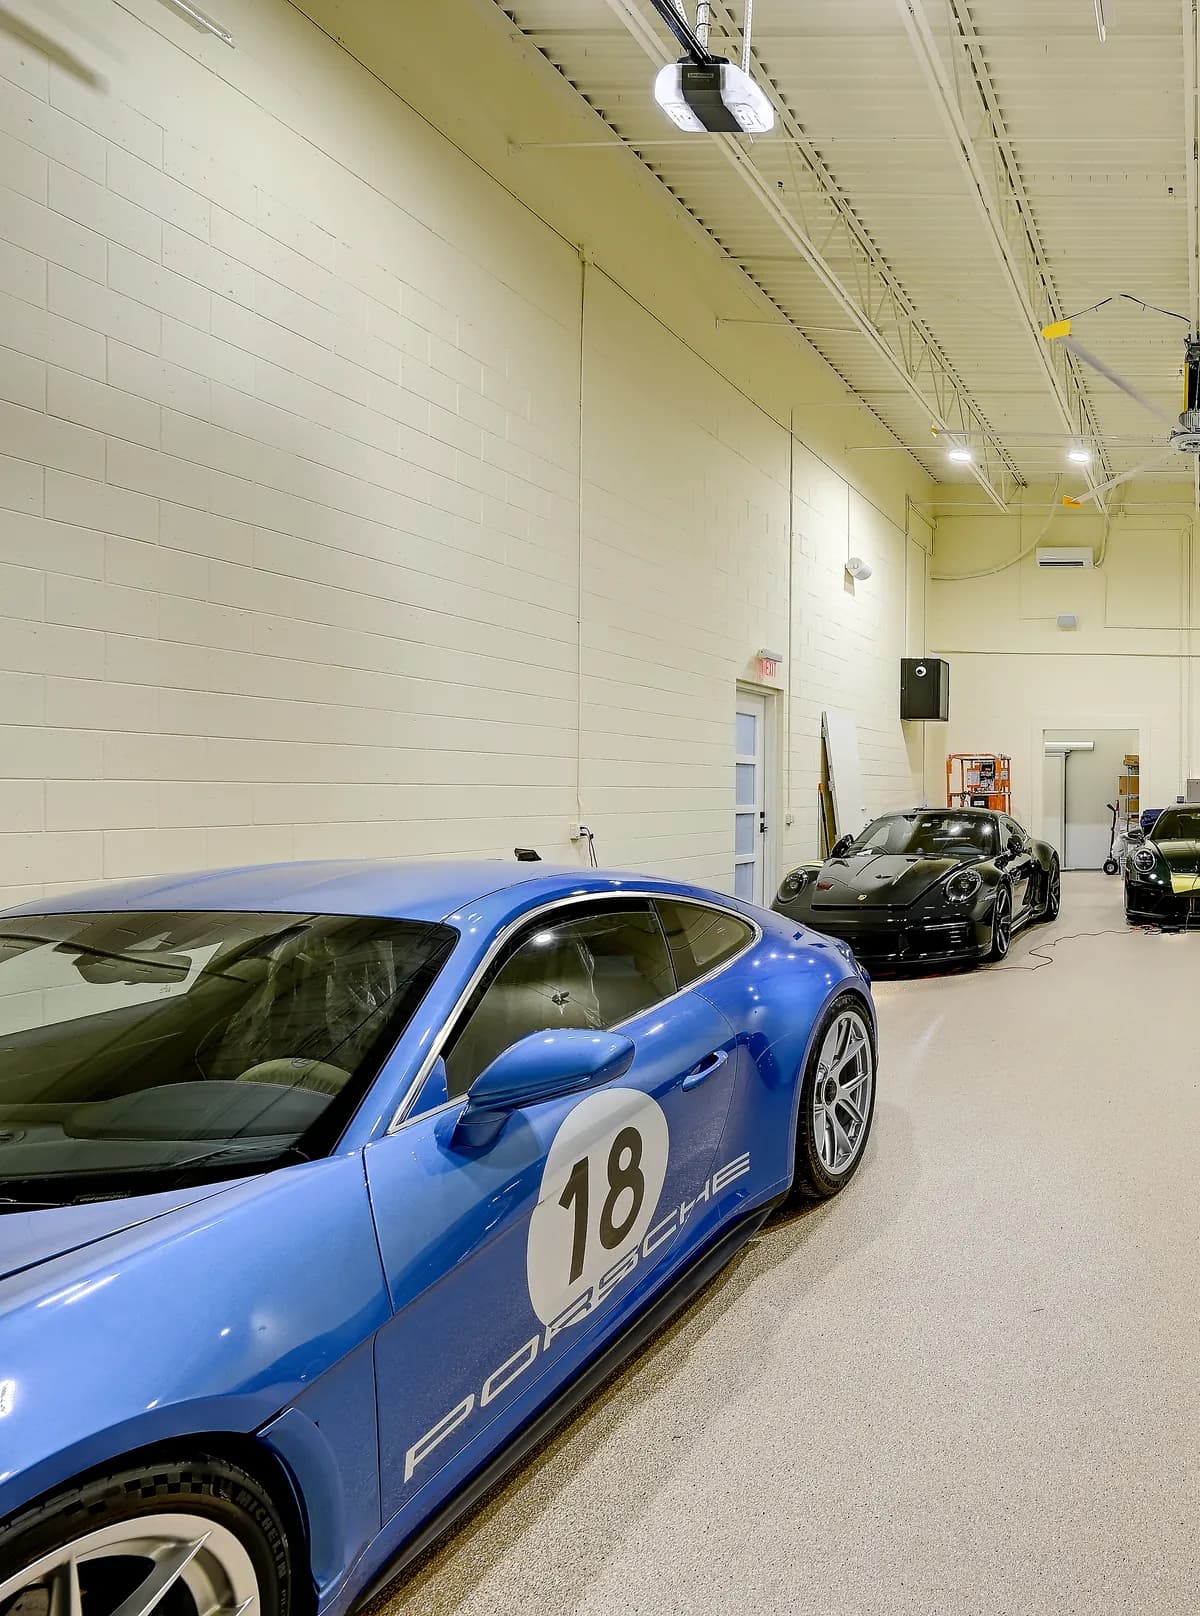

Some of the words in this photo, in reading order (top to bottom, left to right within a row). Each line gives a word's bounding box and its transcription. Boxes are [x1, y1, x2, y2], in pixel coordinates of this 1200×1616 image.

[558, 1126, 645, 1286] 18
[404, 1151, 751, 1484] PORSCHE
[236, 1488, 288, 1579] MICHELIN
